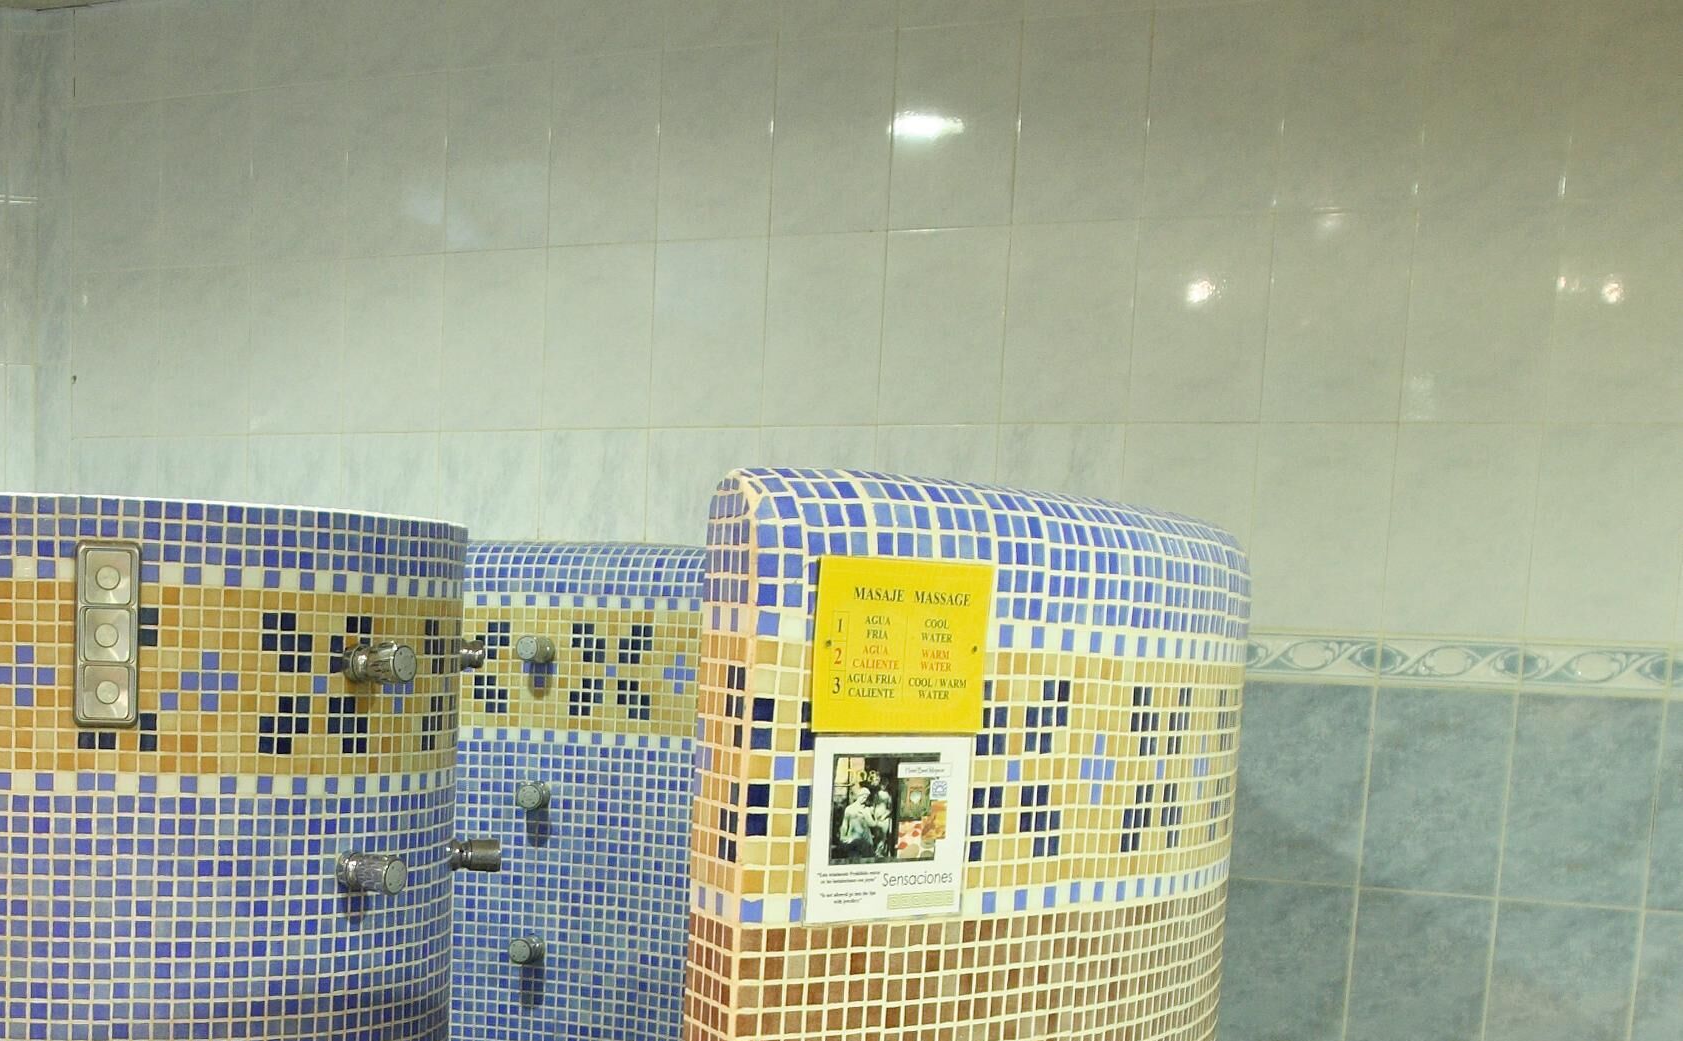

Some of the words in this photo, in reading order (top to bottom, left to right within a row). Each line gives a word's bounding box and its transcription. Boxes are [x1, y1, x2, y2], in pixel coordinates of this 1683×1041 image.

[854, 587, 905, 603] MASAJE
[914, 591, 971, 607] MASSAGE
[837, 618, 843, 633] 1
[864, 615, 891, 626] AGUA
[924, 618, 950, 630] COOL
[866, 629, 889, 640] FRIA
[921, 632, 953, 643] WATER
[833, 647, 842, 665] 2
[862, 645, 889, 655] AGUA
[921, 648, 950, 660] WARM
[852, 658, 900, 670] CALIENTE
[920, 661, 952, 673] WATER
[832, 676, 841, 694] 3
[846, 673, 873, 684] AGUA
[875, 674, 897, 685] FRIA
[908, 677, 933, 687] COOL
[940, 678, 967, 689] WARM
[847, 687, 895, 699] CALIENTE
[918, 689, 950, 700] WATER
[882, 870, 953, 887] Sensaciones
